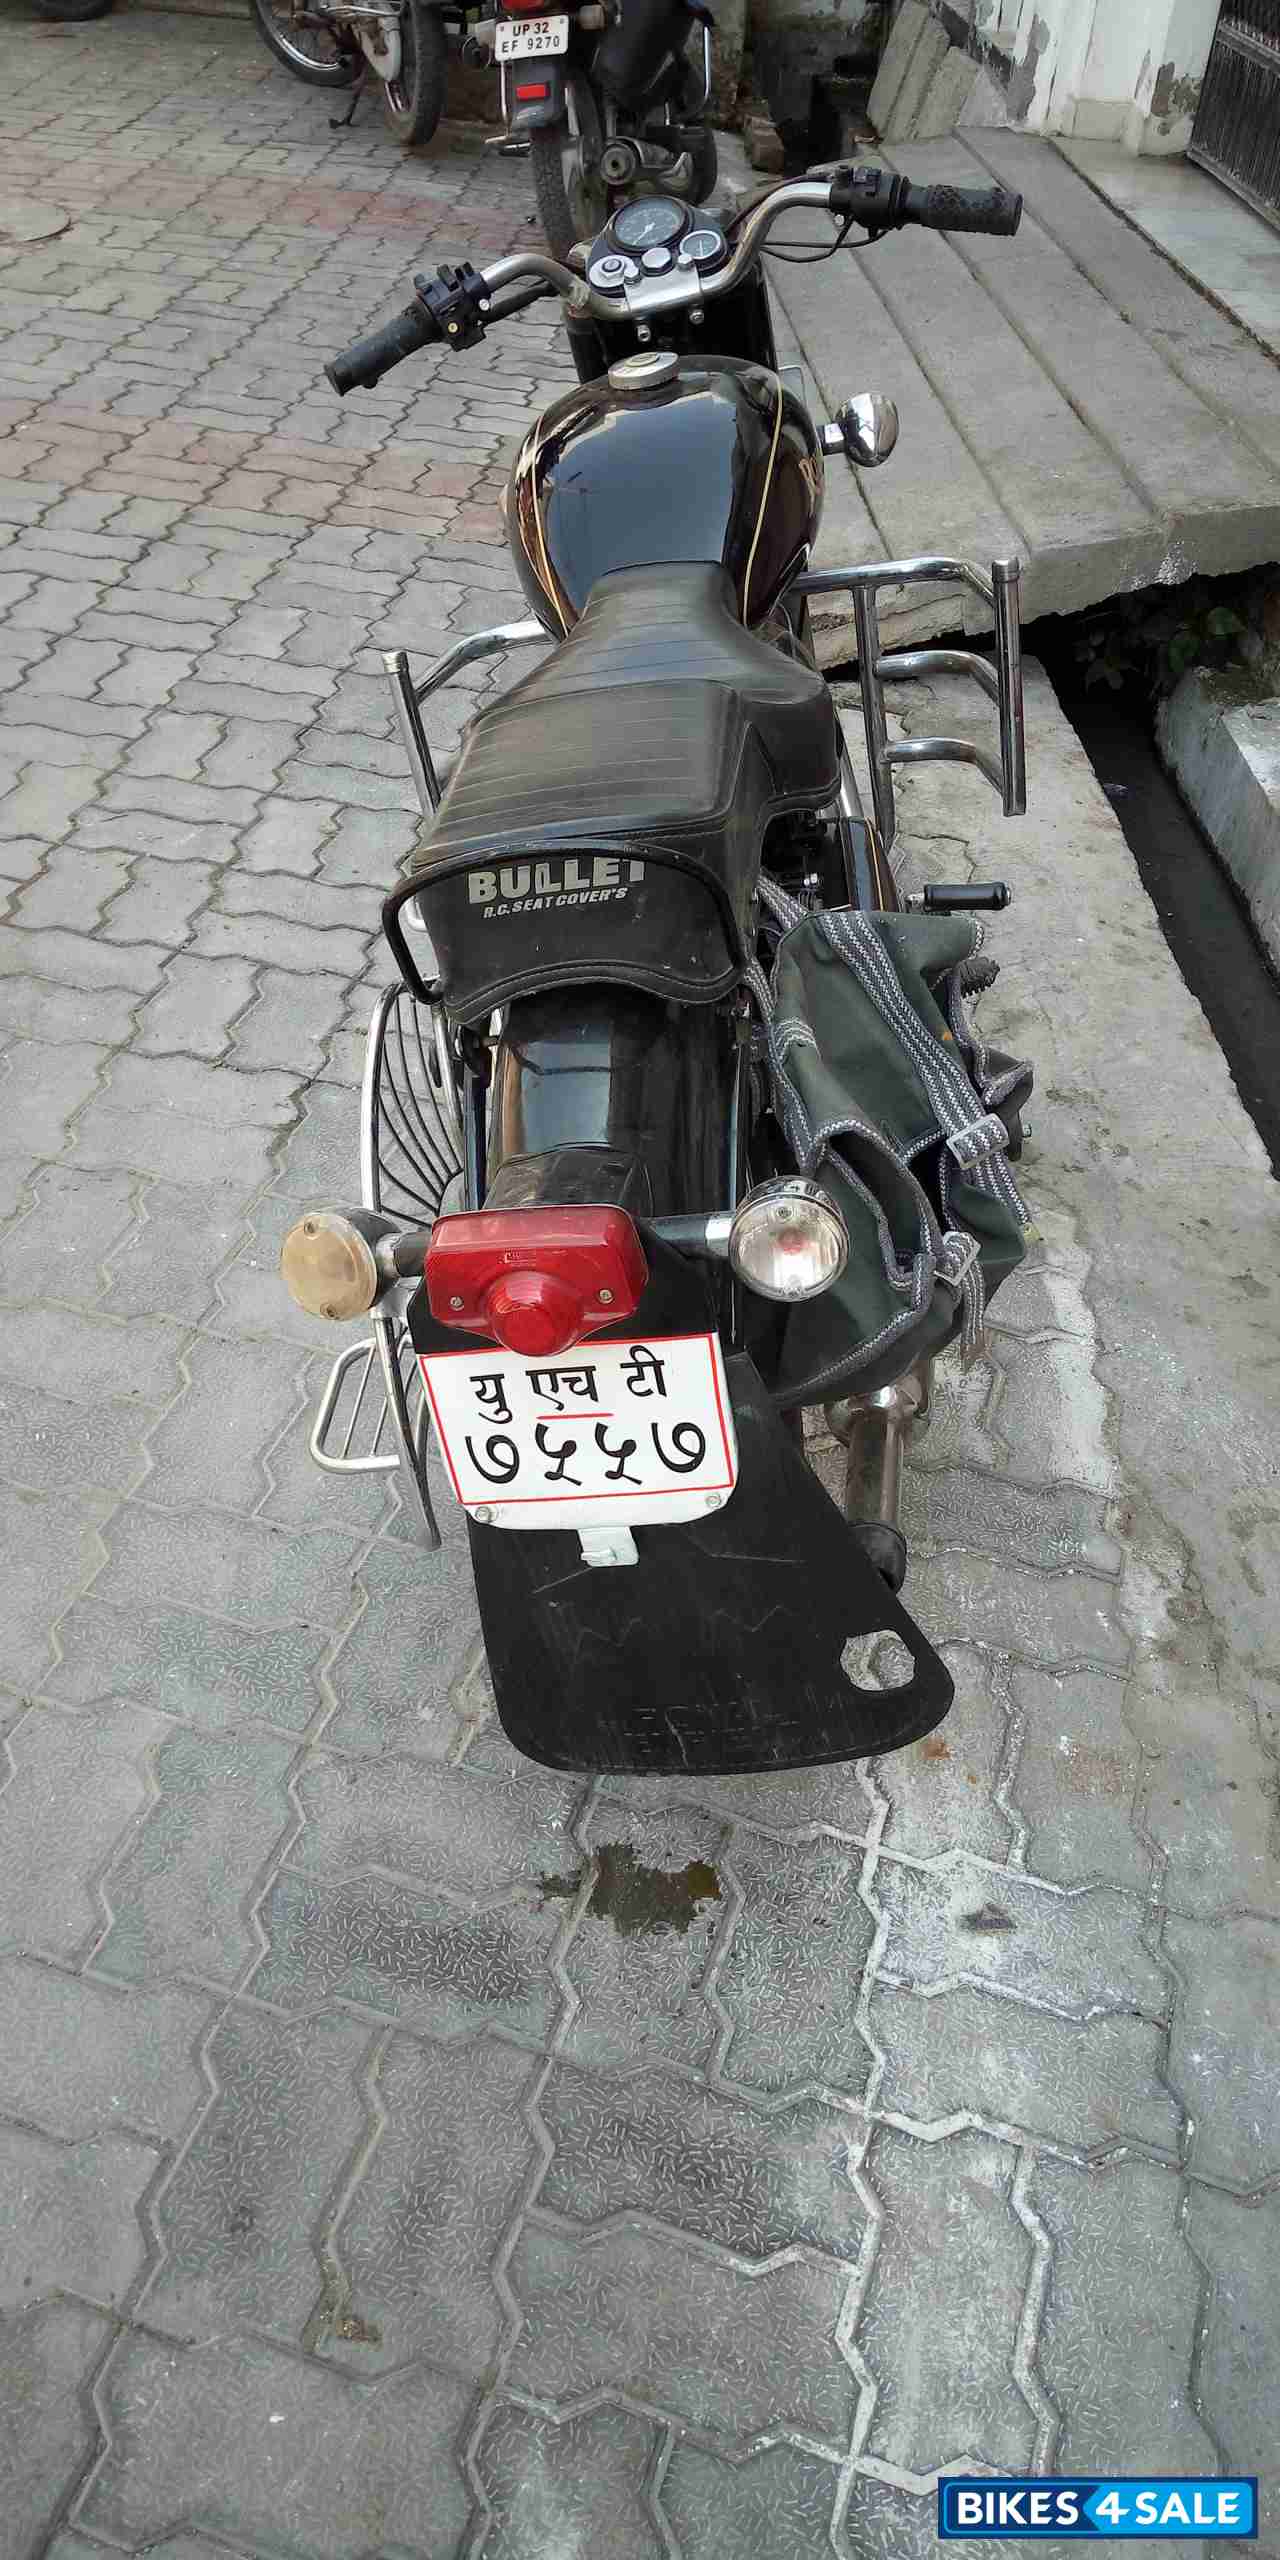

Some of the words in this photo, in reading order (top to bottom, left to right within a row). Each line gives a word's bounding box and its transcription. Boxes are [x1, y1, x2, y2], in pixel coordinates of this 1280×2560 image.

[502, 39, 519, 53] EF
[527, 35, 560, 50] 9270
[512, 23, 530, 37] UP
[534, 21, 549, 34] 32
[468, 856, 645, 904] BULLET
[525, 1365, 599, 1411] एच
[620, 1345, 667, 1397] टी
